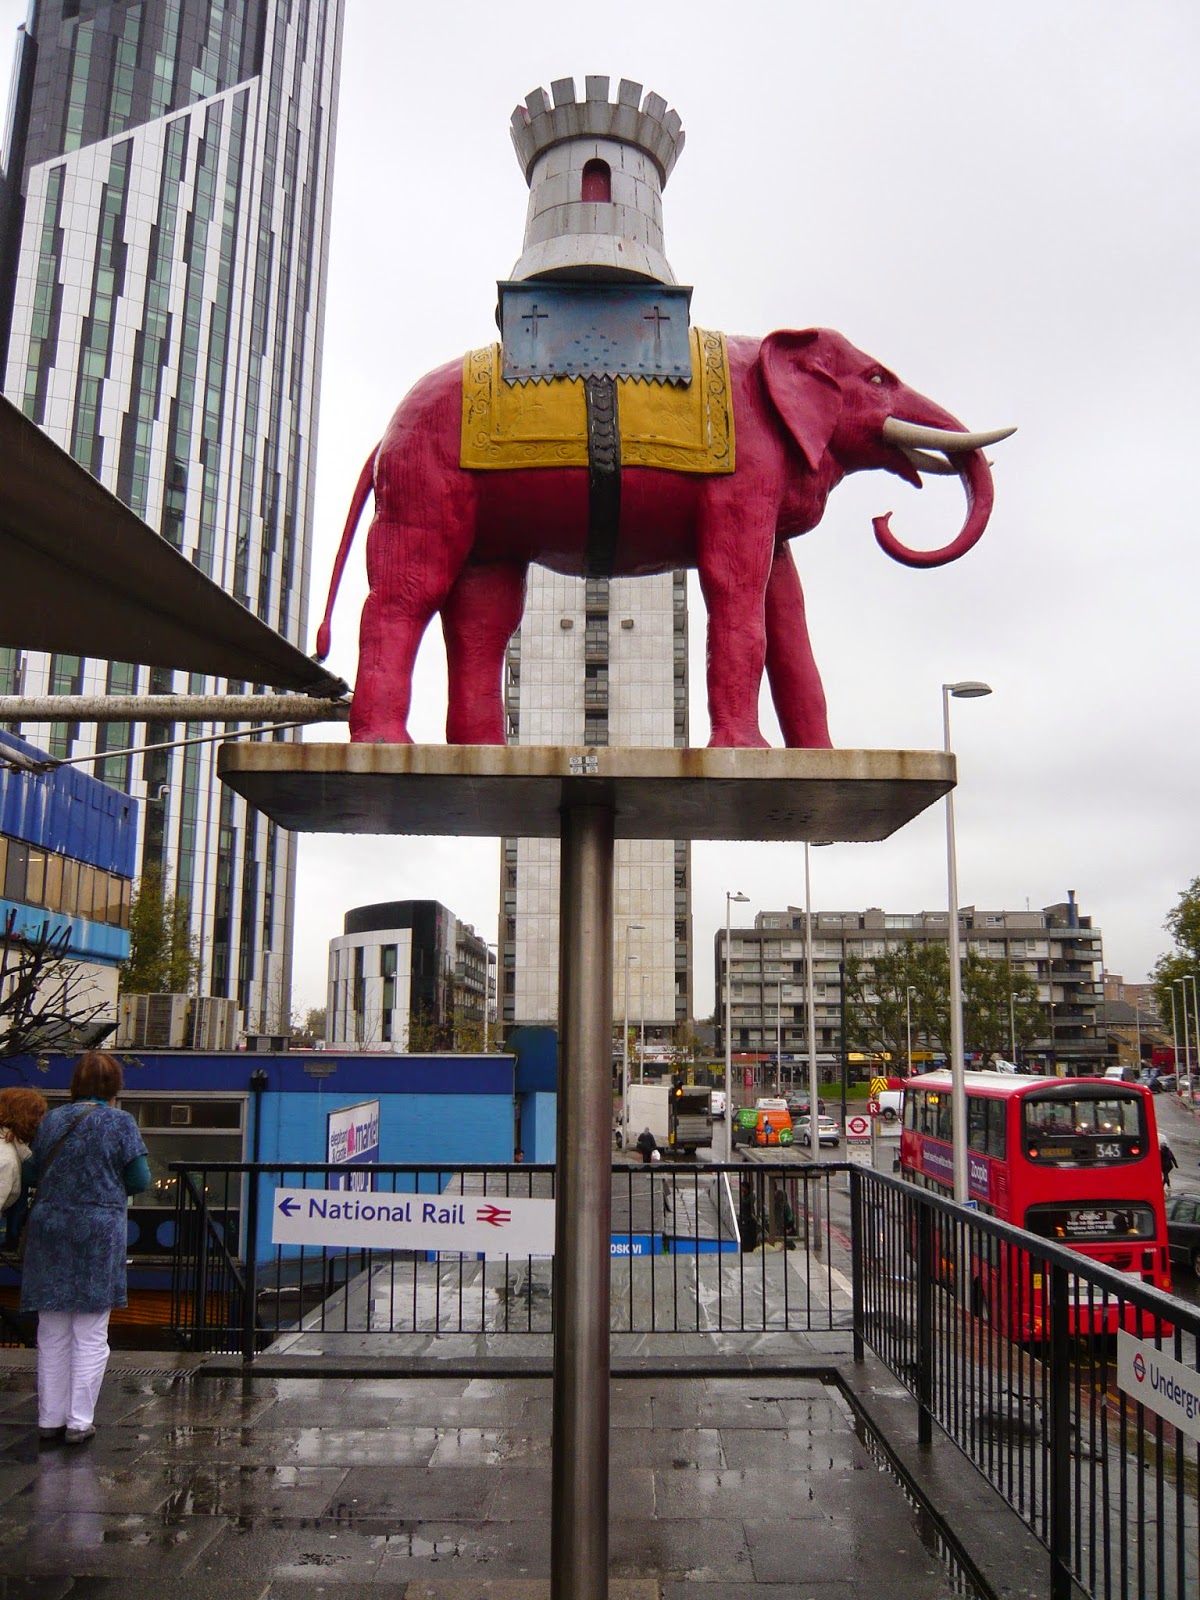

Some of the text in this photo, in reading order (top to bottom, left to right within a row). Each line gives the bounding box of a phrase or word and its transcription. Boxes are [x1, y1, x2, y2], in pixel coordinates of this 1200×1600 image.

[870, 1103, 878, 1113] R
[331, 1128, 348, 1149] elephant
[356, 1113, 378, 1153] market
[336, 1144, 347, 1162] castle
[1096, 1143, 1121, 1158] 343
[971, 1160, 988, 1183] Zoopla
[308, 1198, 465, 1225] National Rail
